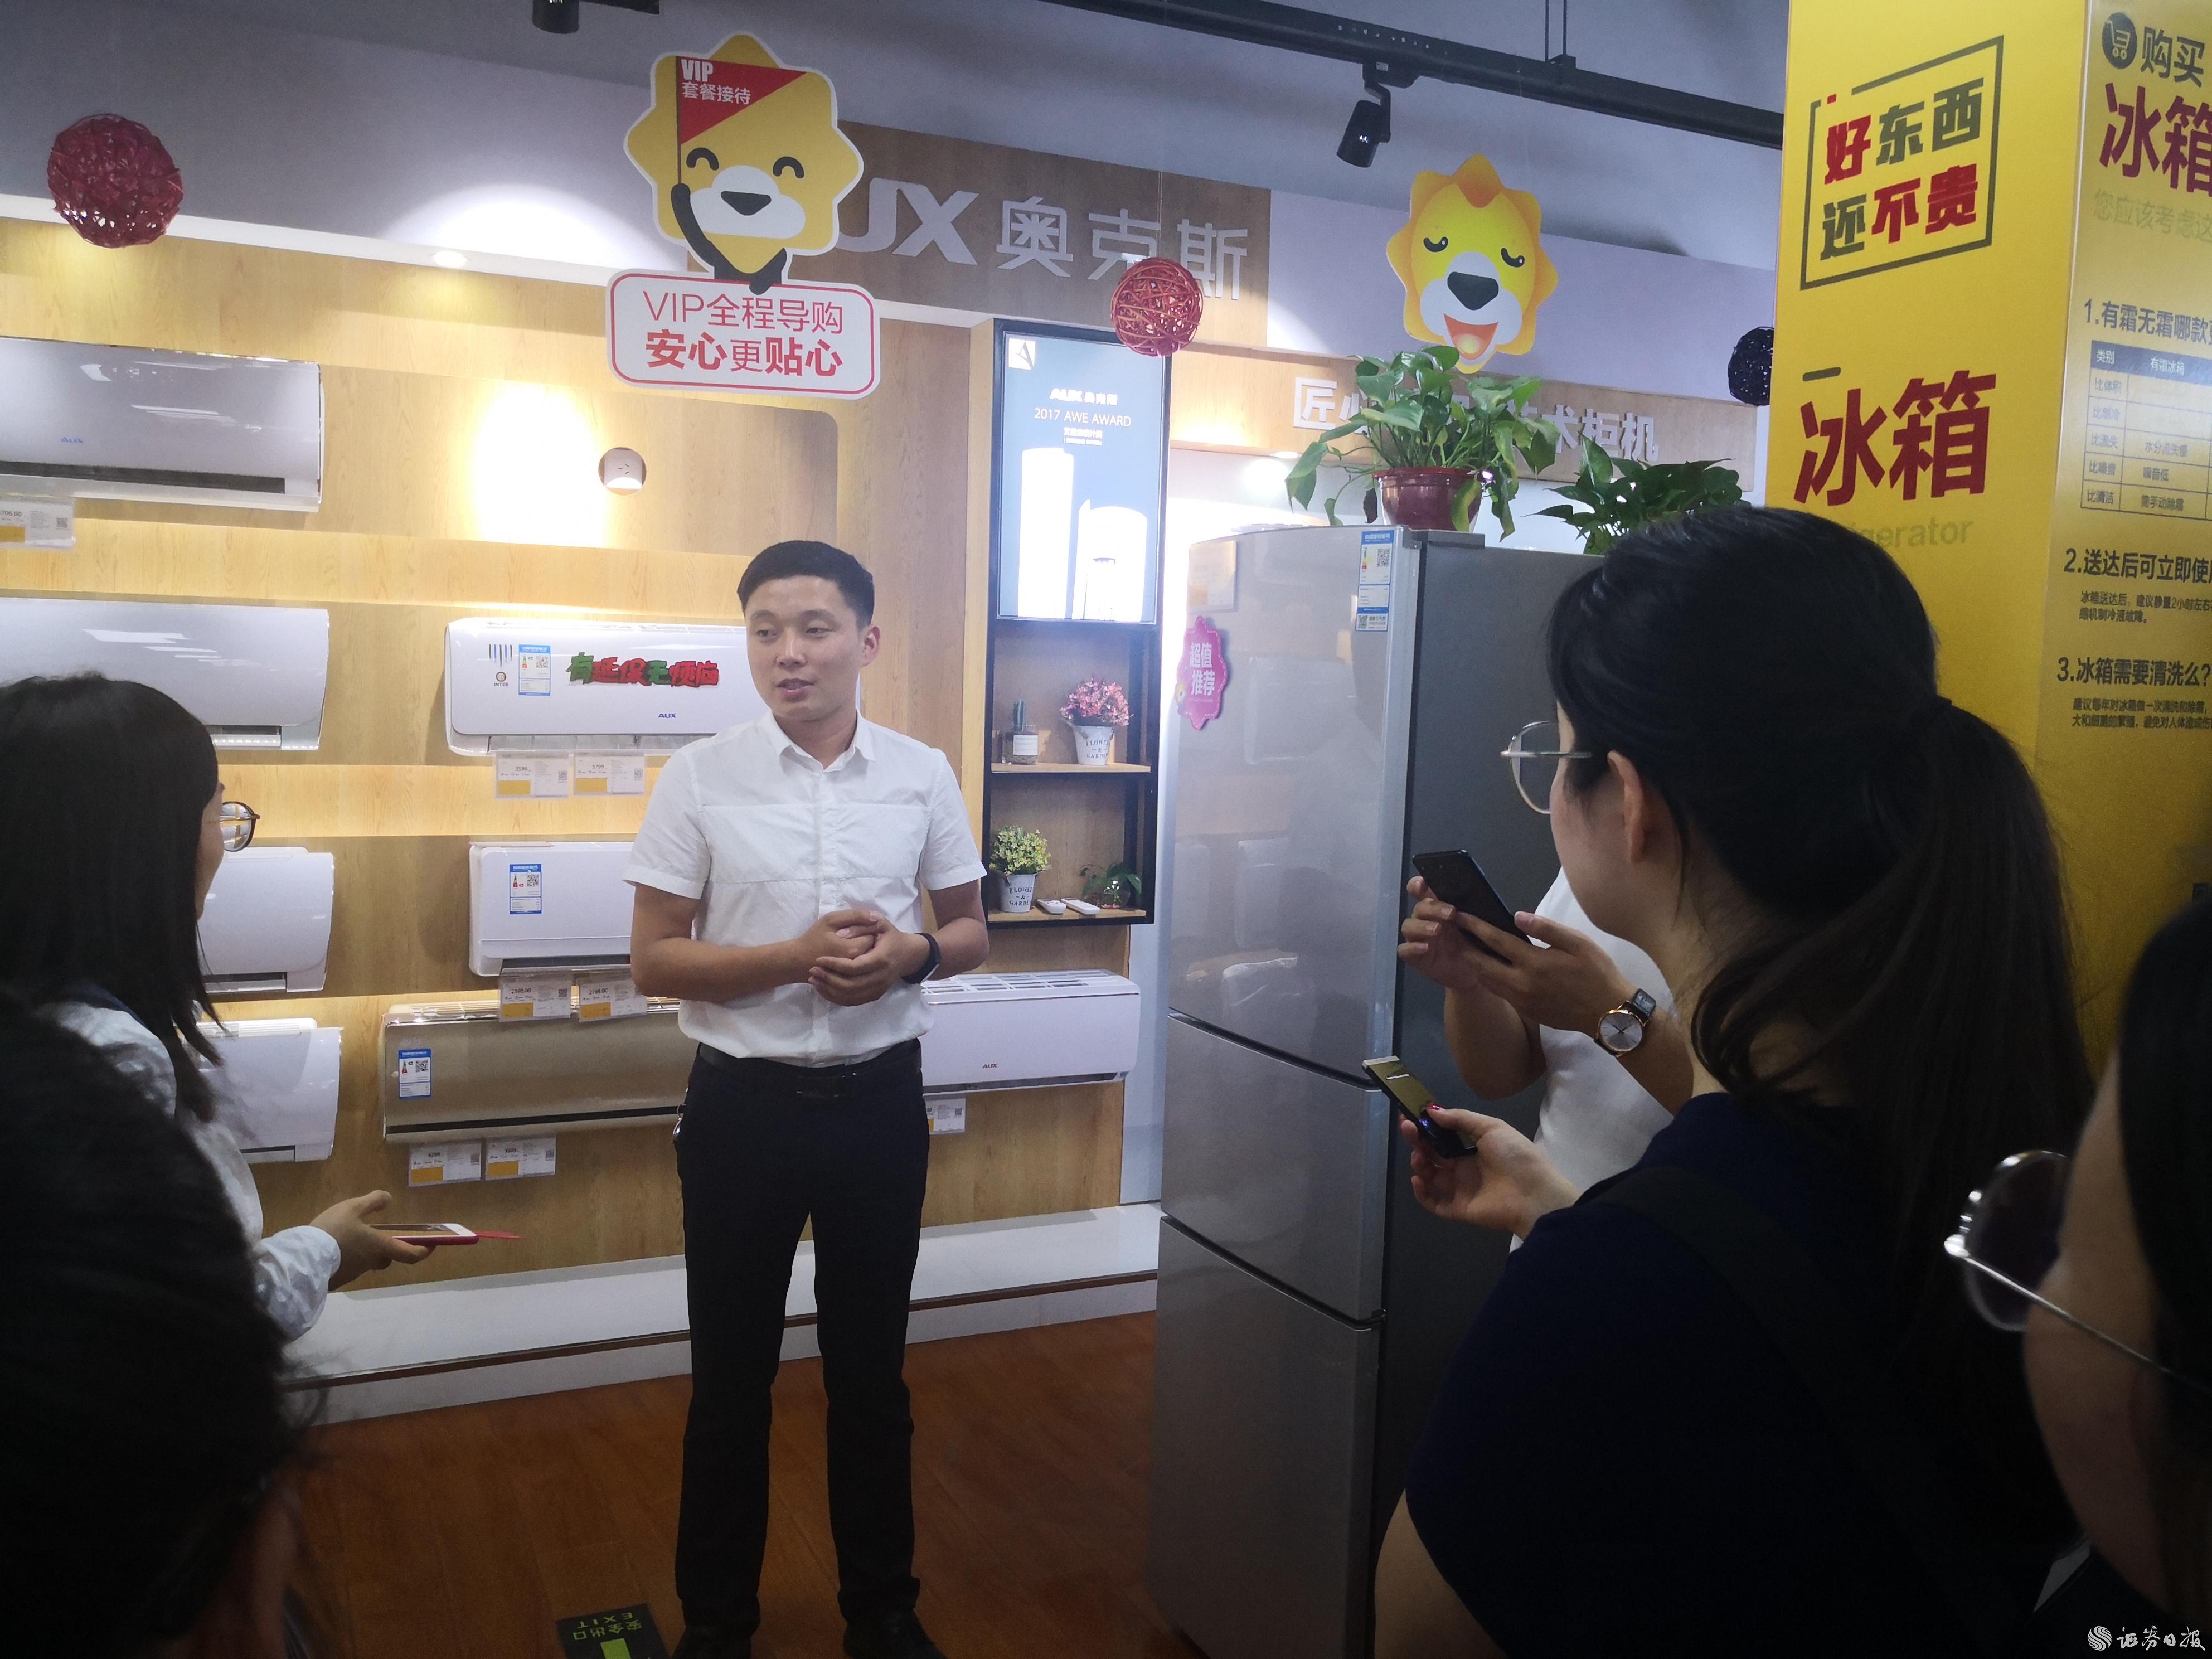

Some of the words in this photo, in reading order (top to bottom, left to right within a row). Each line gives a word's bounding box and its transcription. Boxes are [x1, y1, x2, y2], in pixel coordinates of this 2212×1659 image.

[681, 59, 714, 83] VIP
[2140, 26, 2205, 88] 购买
[681, 81, 751, 105] 套餐接待
[1823, 77, 1985, 185] 好东西
[2099, 83, 2212, 197] 冰箱
[1820, 163, 1978, 261] 还不贵
[835, 177, 979, 266] UX
[996, 196, 1248, 301] 奥克斯
[643, 290, 844, 335] VIP全程导购
[645, 328, 843, 377] 安心更贴心
[2096, 348, 2116, 365] 类别
[1034, 407, 1061, 420] 2017
[1063, 410, 1089, 424] AWE
[1091, 413, 1132, 427] AWARD
[1793, 369, 1997, 507] 冰箱
[2063, 547, 2212, 584] 2.送达后可立即使
[573, 1619, 642, 1640] 安全出口
[577, 1612, 634, 1628] EXIT
